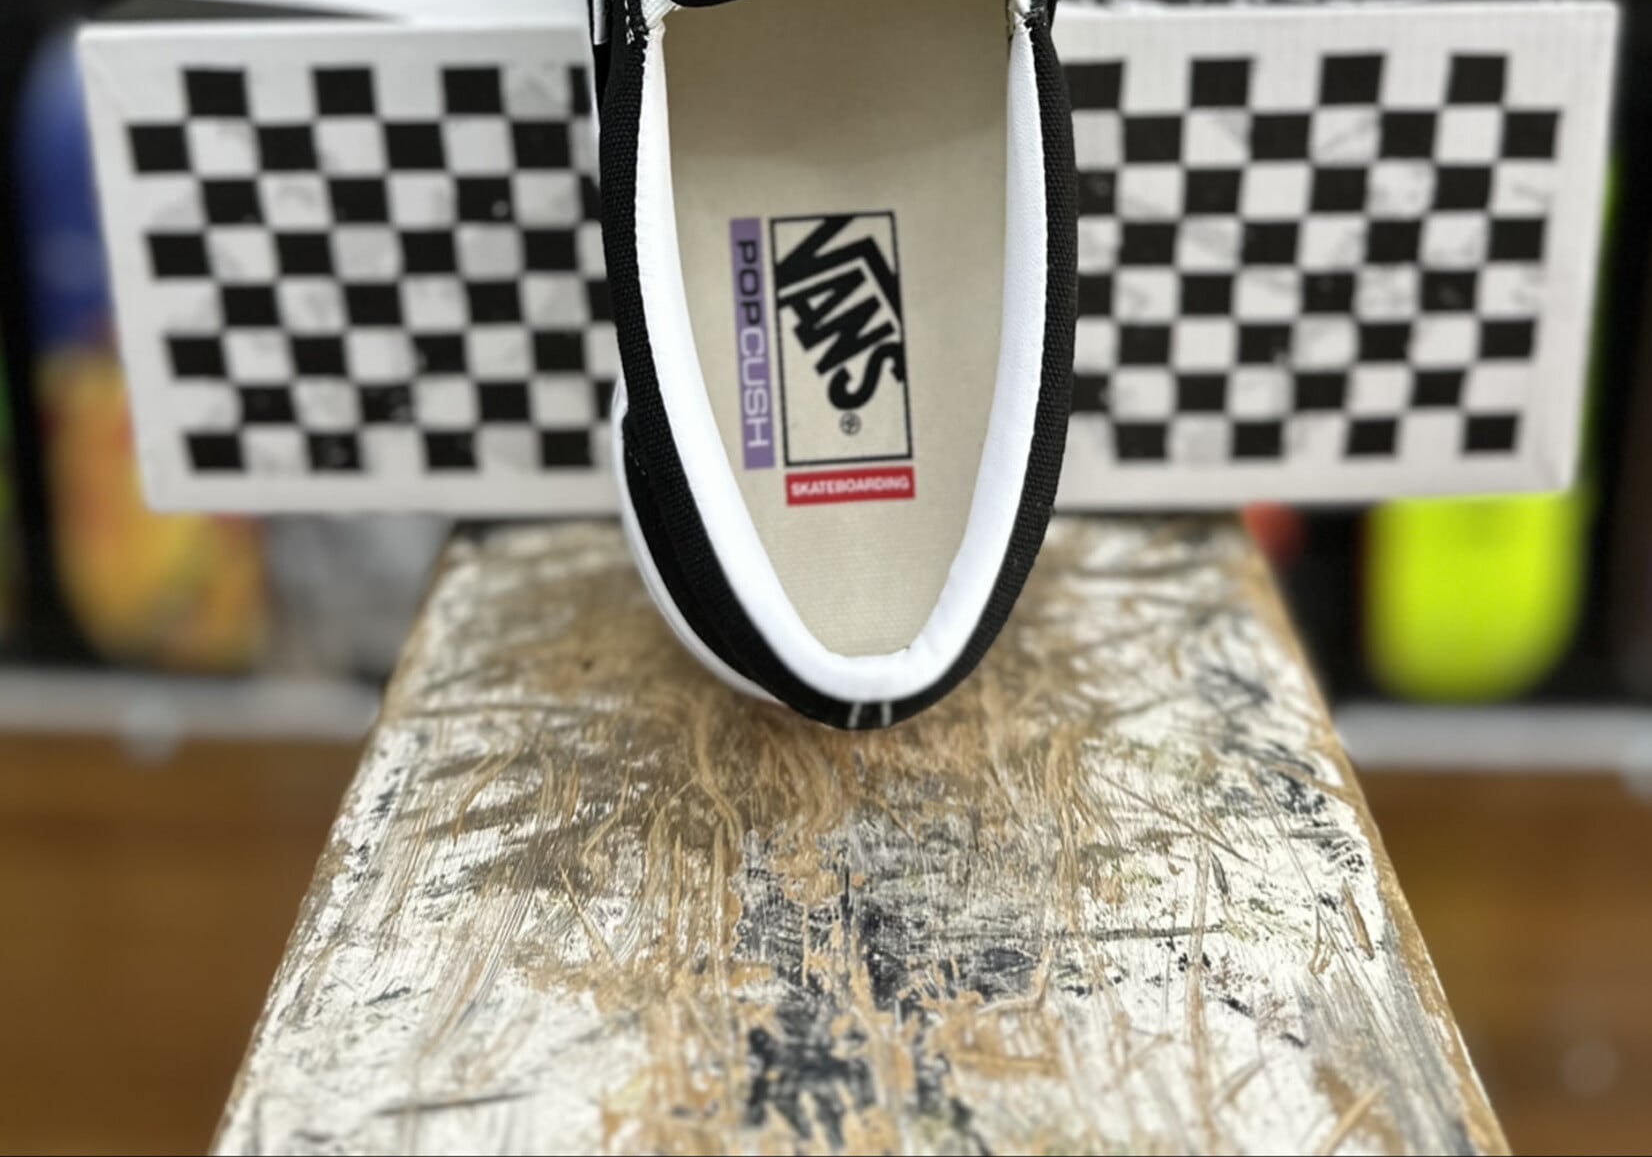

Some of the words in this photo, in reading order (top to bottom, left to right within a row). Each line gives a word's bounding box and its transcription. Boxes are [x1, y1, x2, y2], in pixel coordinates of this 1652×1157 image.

[737, 240, 769, 448] POPCUSH
[773, 213, 904, 411] VANS
[790, 475, 910, 497] SKATEBOARDING
